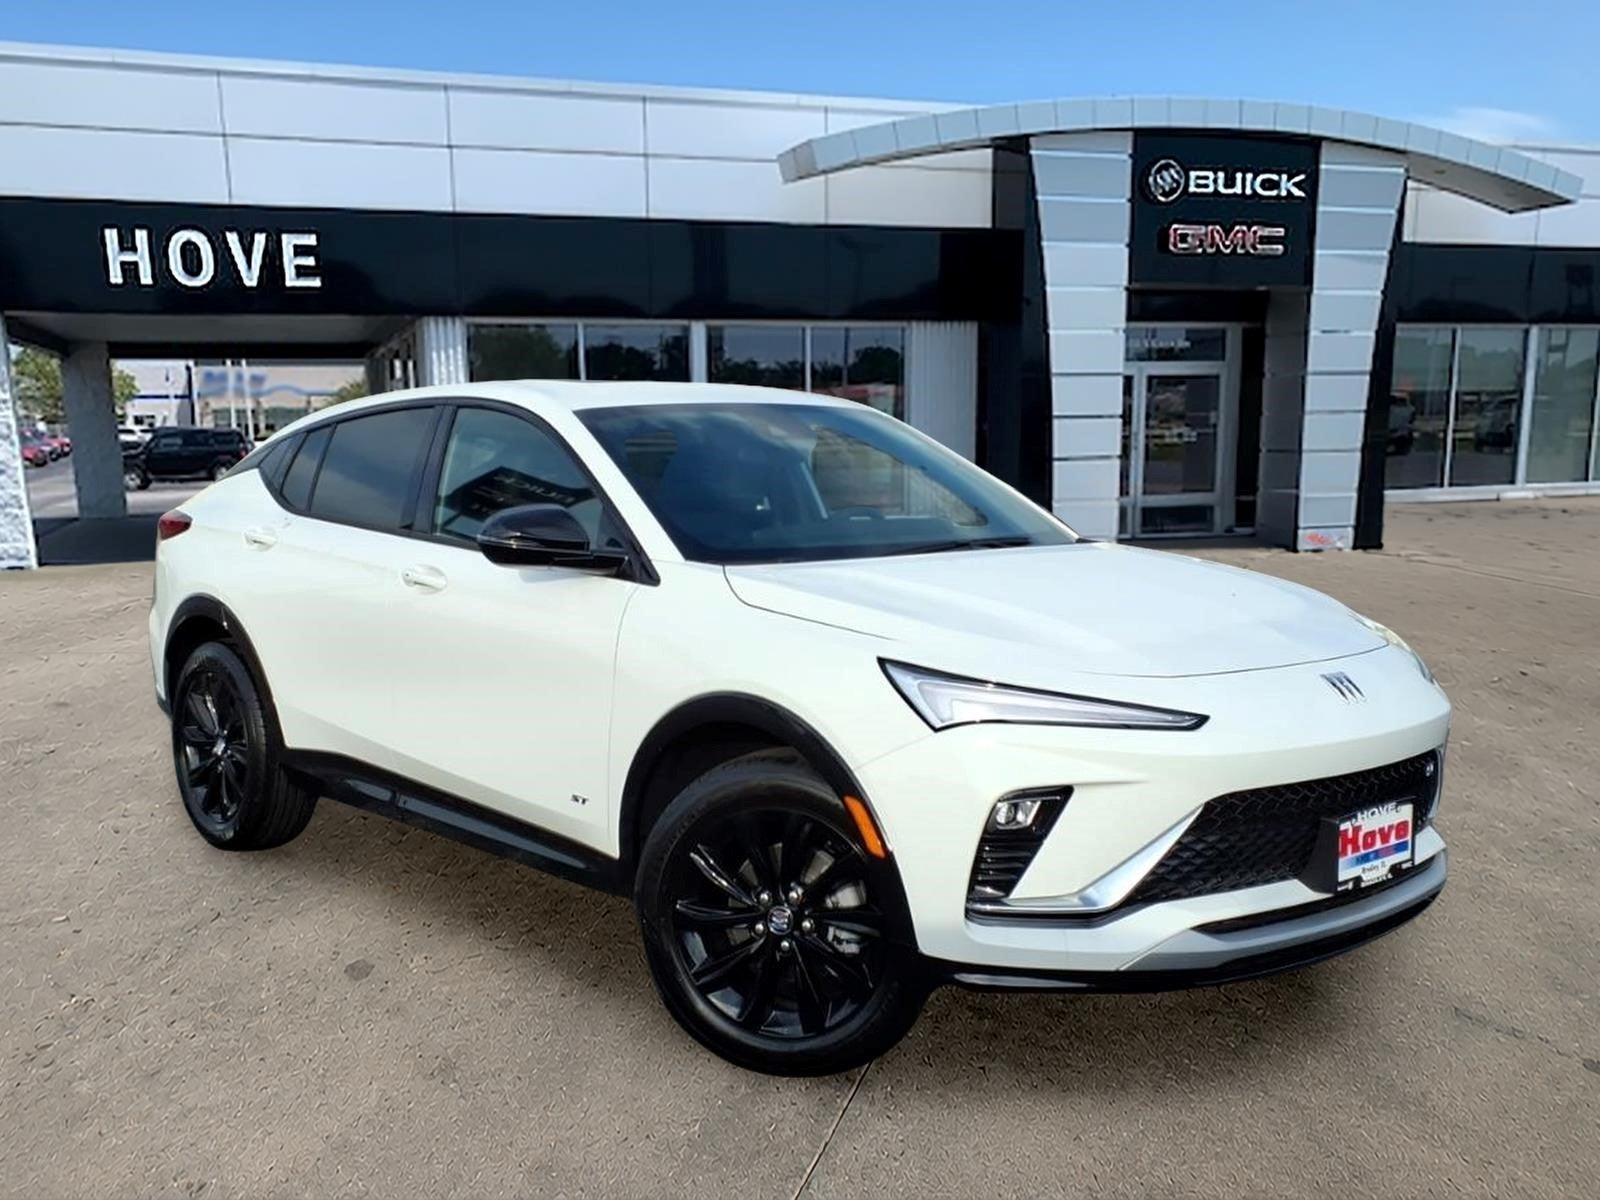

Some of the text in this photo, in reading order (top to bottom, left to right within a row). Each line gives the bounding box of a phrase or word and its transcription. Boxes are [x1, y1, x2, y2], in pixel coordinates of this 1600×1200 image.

[1188, 170, 1307, 198] BUICK
[1168, 223, 1285, 255] GMC
[103, 227, 322, 288] HOVE
[1356, 801, 1398, 822] HOVE
[1338, 820, 1410, 859] Hove
